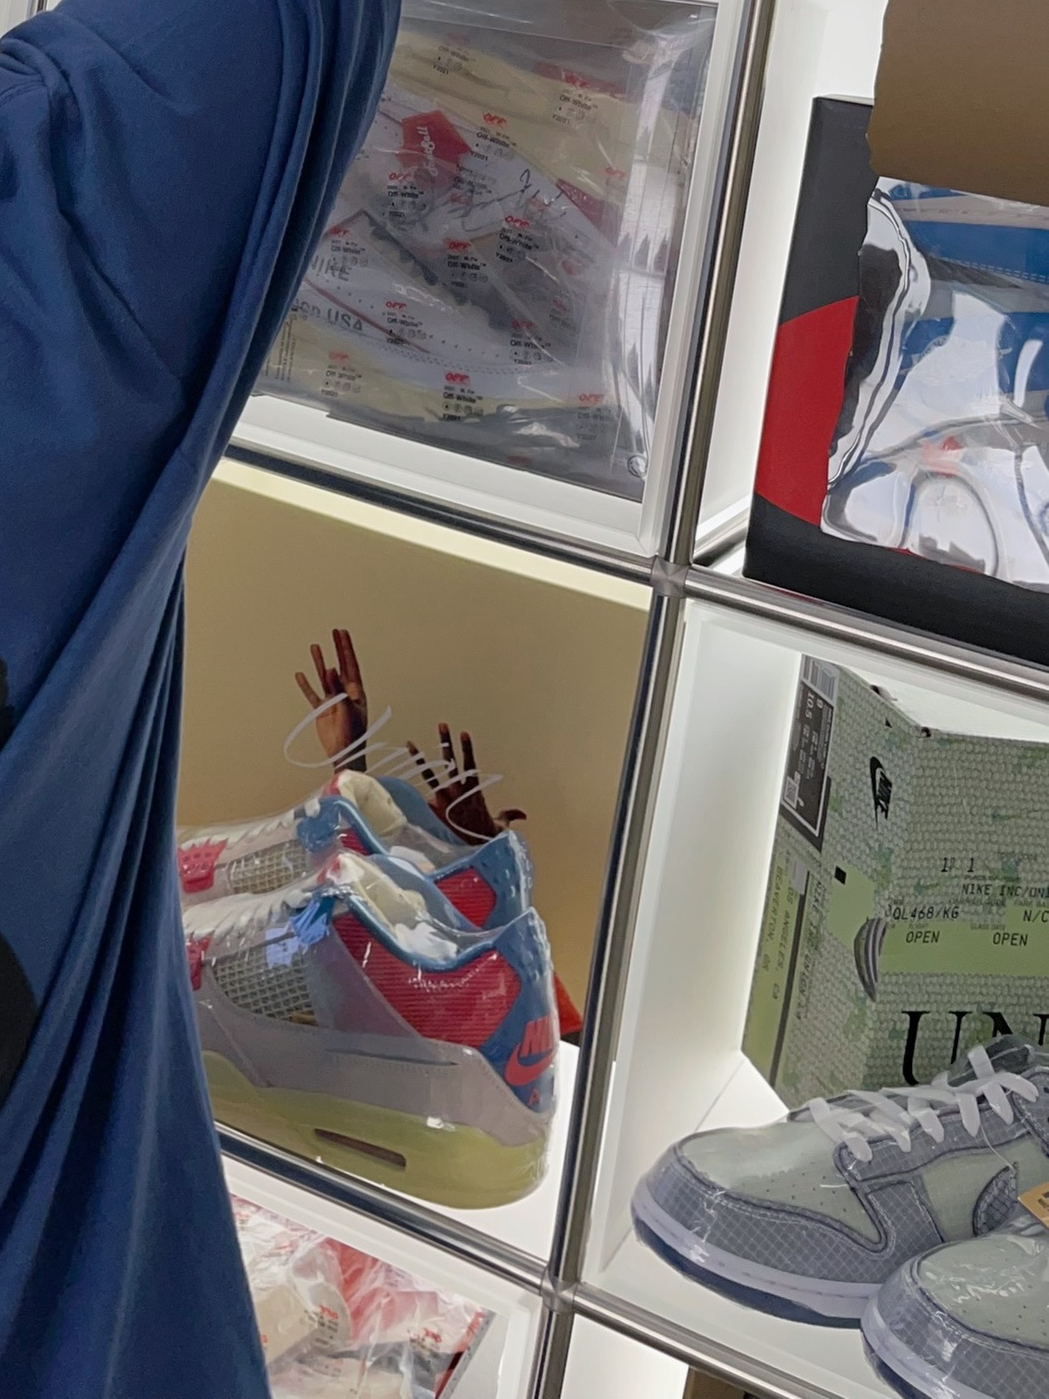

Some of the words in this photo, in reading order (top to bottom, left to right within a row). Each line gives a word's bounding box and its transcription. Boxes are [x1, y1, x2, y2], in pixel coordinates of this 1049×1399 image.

[962, 883, 992, 896] NIKE
[905, 931, 940, 944] OPEN
[993, 932, 1028, 946] OPEN
